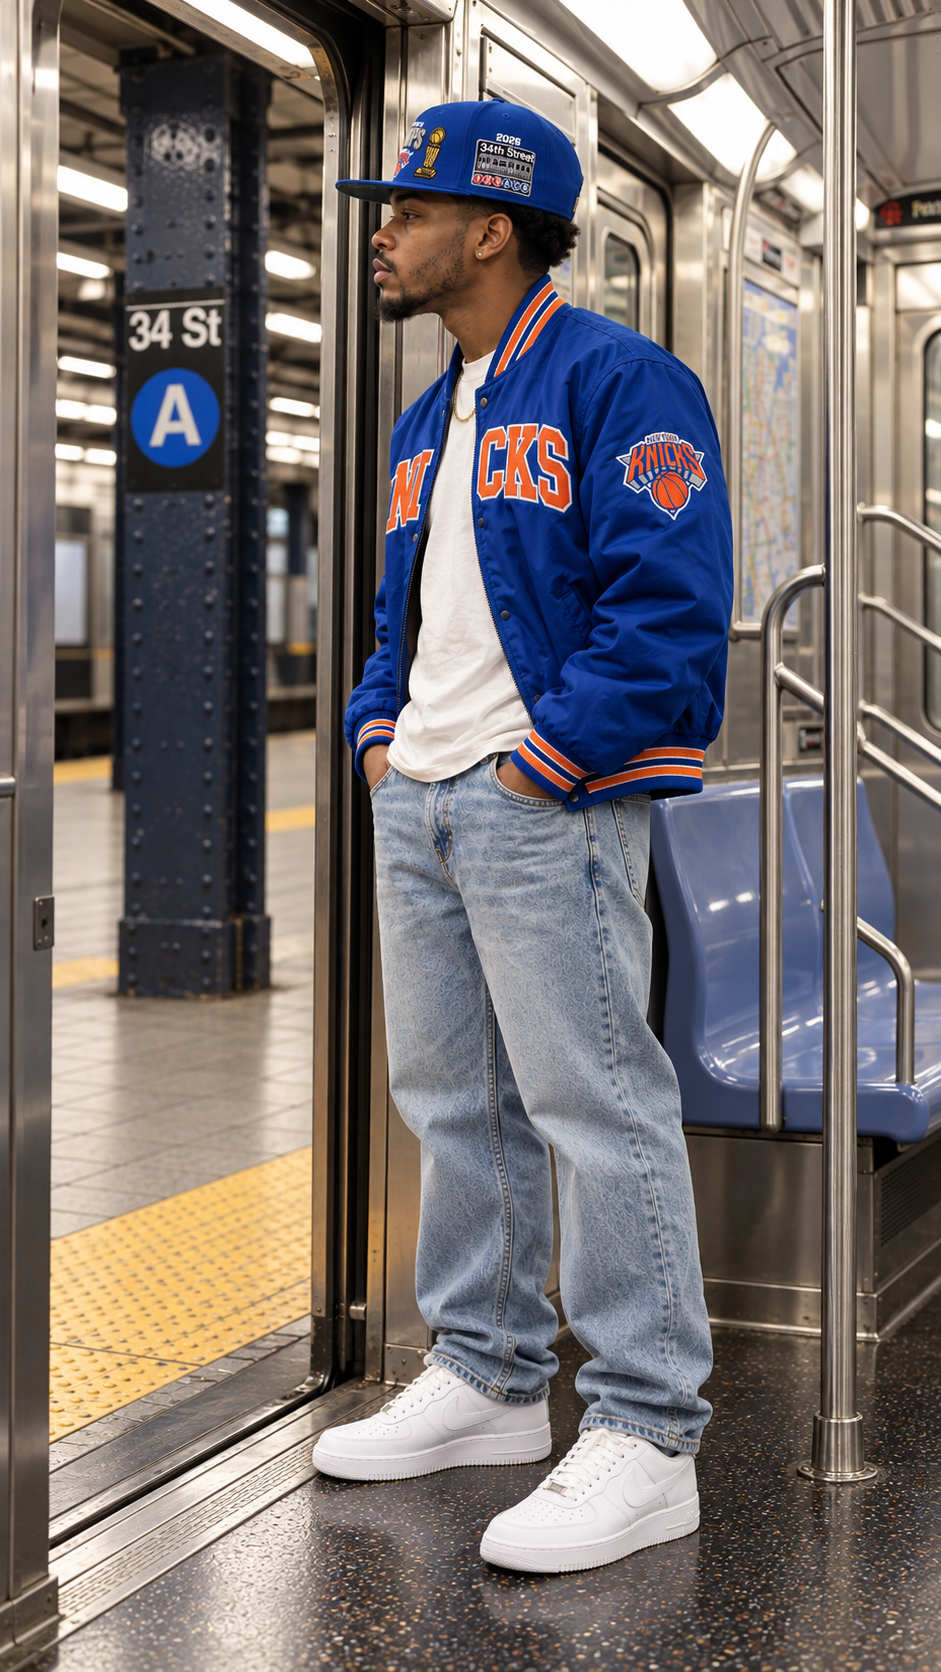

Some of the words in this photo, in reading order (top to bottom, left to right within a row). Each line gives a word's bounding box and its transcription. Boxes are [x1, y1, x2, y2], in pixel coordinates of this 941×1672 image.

[480, 143, 504, 155] 34th
[507, 148, 535, 162] Street
[496, 133, 521, 146] 2026
[128, 310, 172, 352] 34
[181, 306, 222, 349] St
[149, 383, 202, 447] A
[386, 449, 435, 534] NI
[477, 423, 572, 513] CKS
[627, 443, 706, 482] KNICKS
